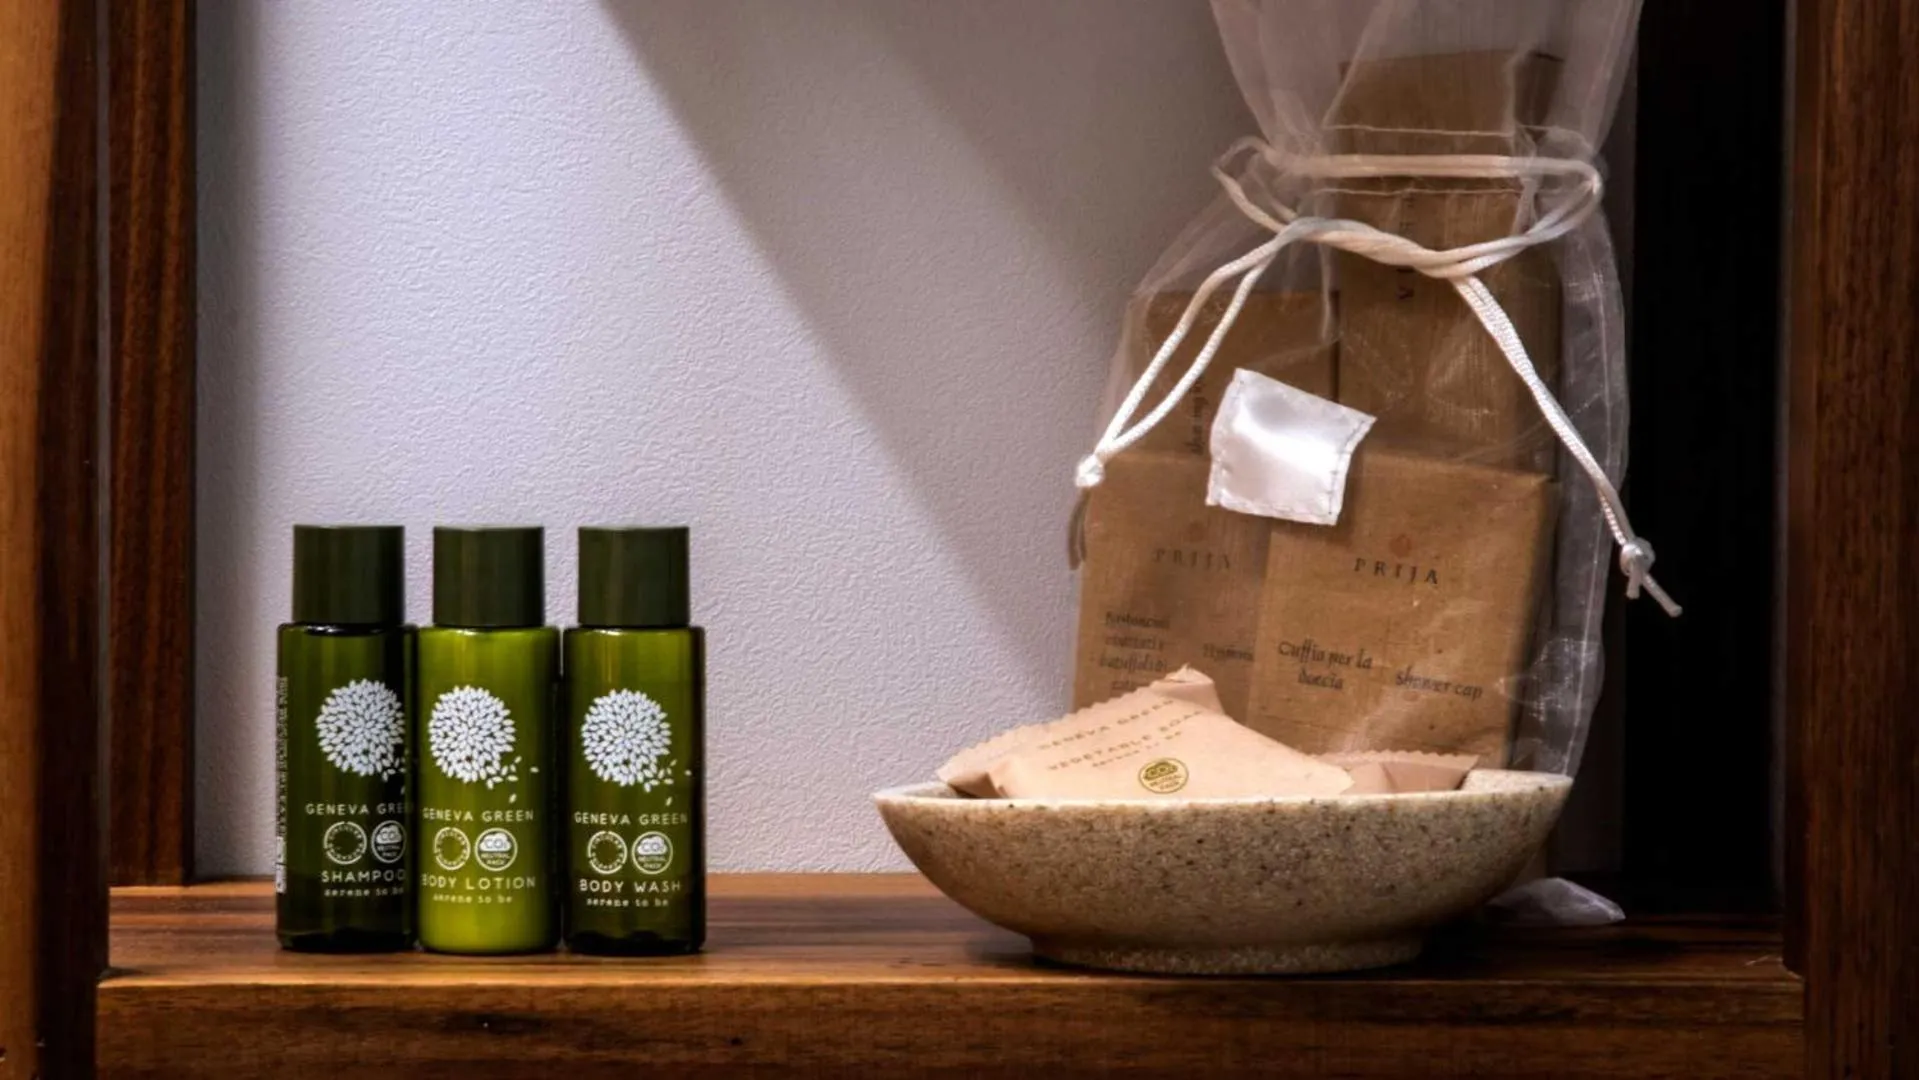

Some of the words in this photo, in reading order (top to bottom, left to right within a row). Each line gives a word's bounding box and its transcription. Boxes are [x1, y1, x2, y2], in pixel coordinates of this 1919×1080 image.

[1354, 557, 1438, 585] PRIJA
[1328, 650, 1354, 667] per
[1355, 647, 1372, 669] la
[1455, 682, 1483, 702] cap
[304, 803, 370, 816] GENEVA
[422, 807, 473, 821] GENEVA
[481, 809, 534, 822] GREEN
[574, 811, 631, 825] GENEVA
[639, 813, 688, 825] GREEN
[421, 873, 457, 888] BODY
[465, 877, 536, 890] LOTION
[579, 879, 624, 893] BODY
[634, 880, 681, 893] WASH
